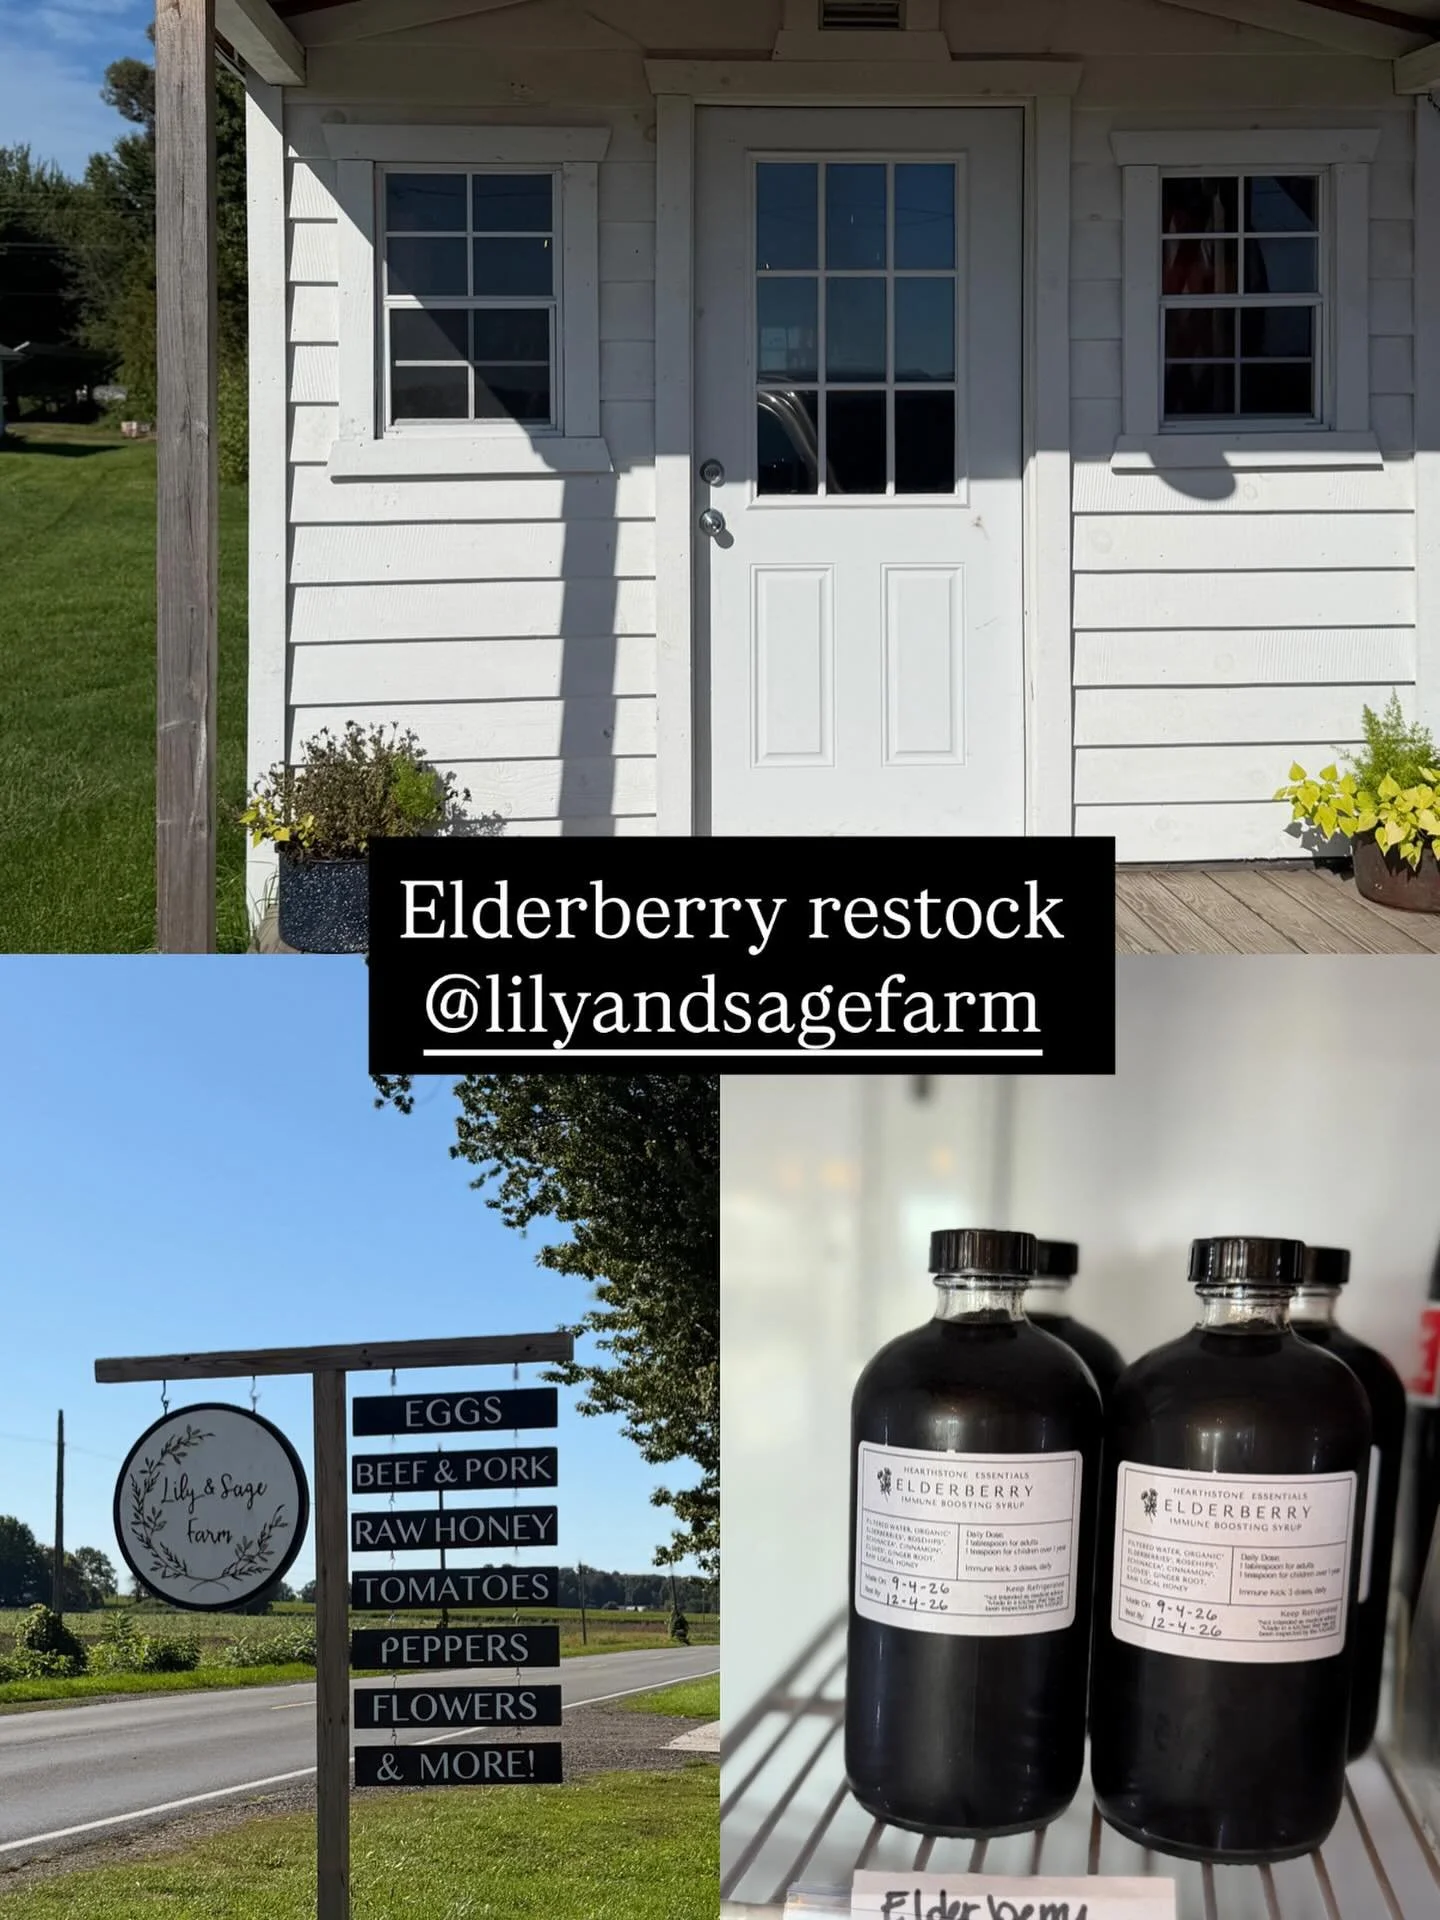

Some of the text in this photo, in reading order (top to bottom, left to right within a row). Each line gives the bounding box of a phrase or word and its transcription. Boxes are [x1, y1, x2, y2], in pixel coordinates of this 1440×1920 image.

[405, 1396, 502, 1427] EGGS
[356, 1456, 552, 1487] BEEF & PORK
[904, 1466, 968, 1478] HEARTHSTONE
[161, 1472, 267, 1515] Lily & Sage
[896, 1478, 1034, 1498] ELDERBERRY
[1173, 1487, 1308, 1500] HEARTHSTONE ESSENTIALS
[901, 1496, 1025, 1510] IMMUNE BOOSTING SYRUP
[1164, 1499, 1312, 1520] ELDERBERRY
[187, 1518, 232, 1544] Farm
[357, 1515, 552, 1544] RAW HONEY
[1170, 1517, 1303, 1532] IMMUNE BOOSTING SYRUP
[965, 1564, 993, 1572] Immune
[366, 1575, 548, 1602] TOMATOES
[892, 1576, 950, 1594] 9-4-26
[1006, 1585, 1025, 1593] Keep
[1239, 1588, 1268, 1596] Immune
[886, 1593, 948, 1611] 12-4-26
[1157, 1599, 1217, 1621] 9-4-26
[1280, 1609, 1300, 1618] Keep
[1152, 1616, 1222, 1637] 12-4-26
[382, 1634, 527, 1662] PEPPERS
[374, 1692, 536, 1720] FLOWERS
[377, 1750, 536, 1781] & MORE!
